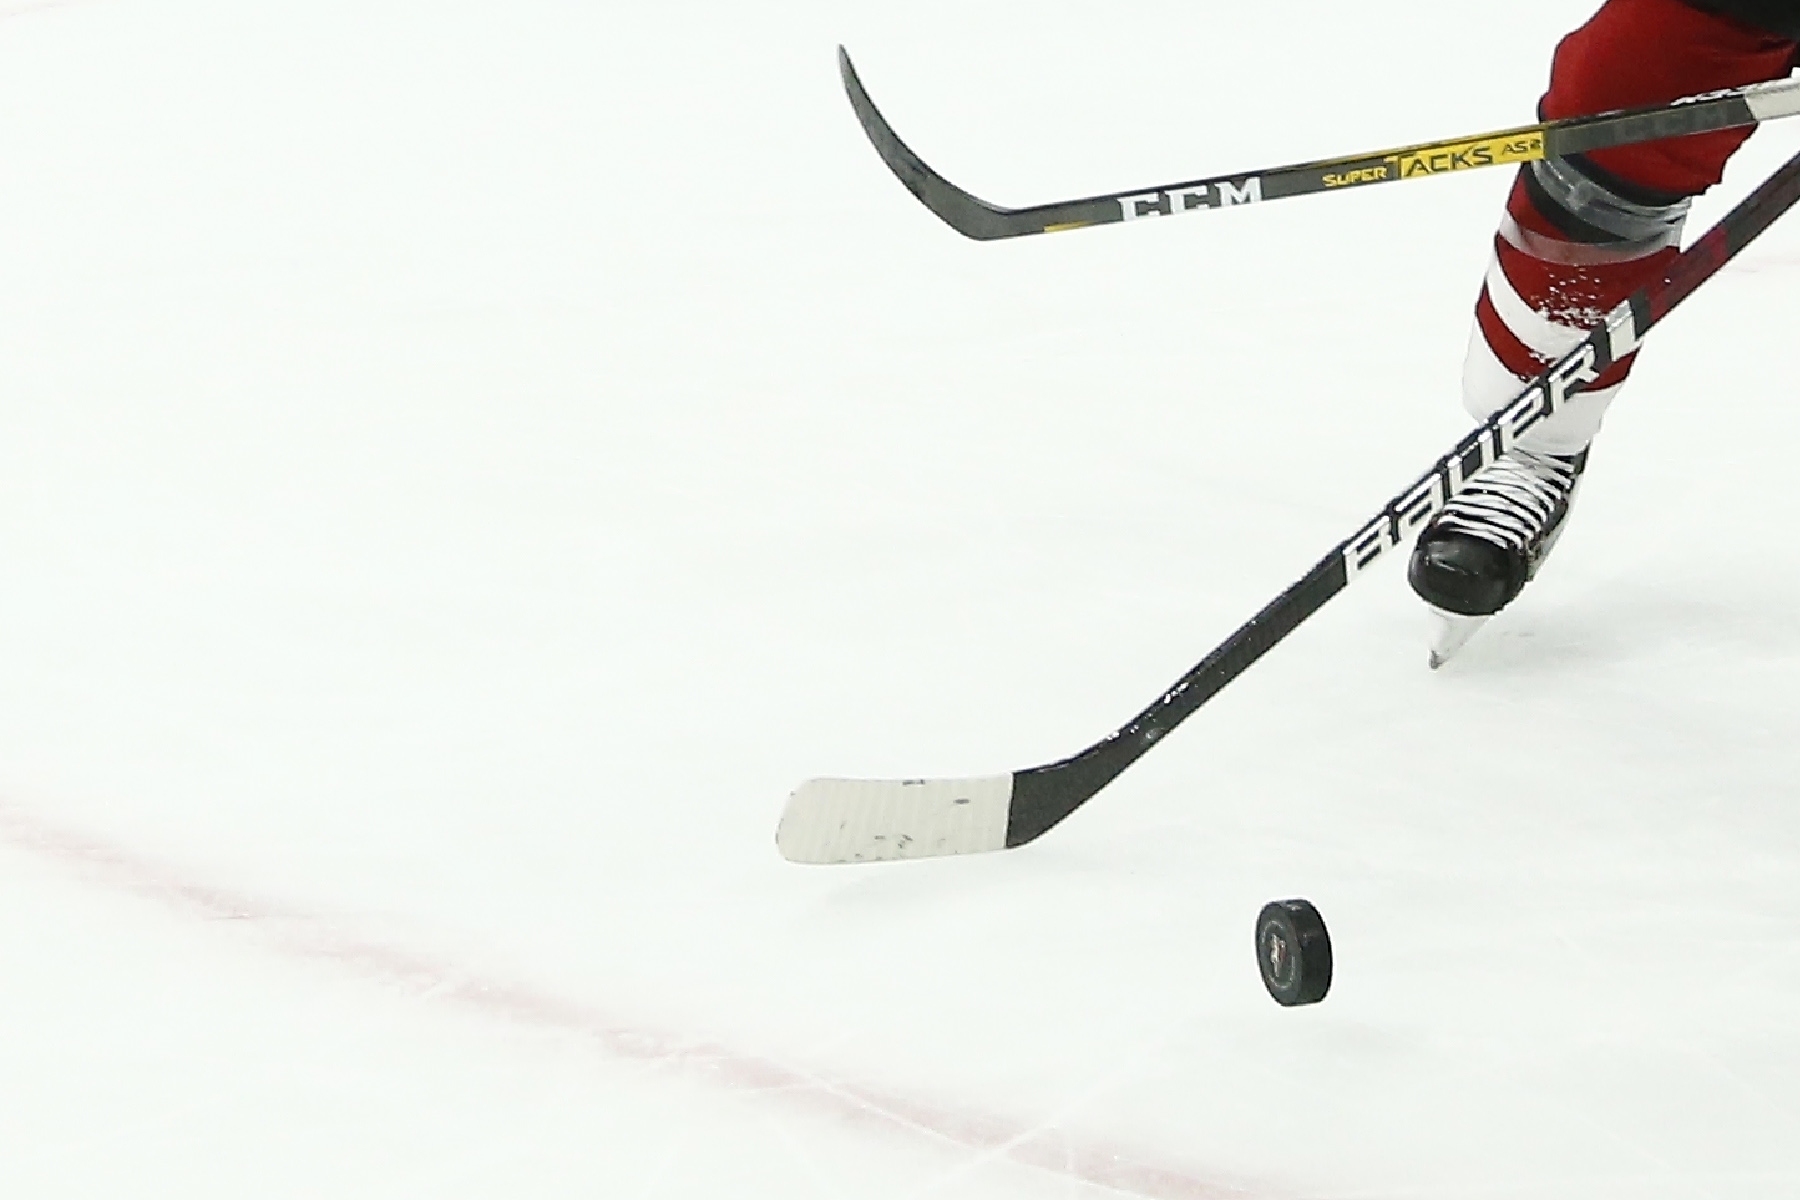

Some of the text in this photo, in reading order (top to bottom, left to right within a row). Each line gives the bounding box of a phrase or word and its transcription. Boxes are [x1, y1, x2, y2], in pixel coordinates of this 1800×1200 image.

[1321, 166, 1388, 188] SUPER
[1382, 145, 1494, 179] TACKS
[1116, 176, 1263, 223] CCM
[1344, 342, 1600, 584] BAUER
